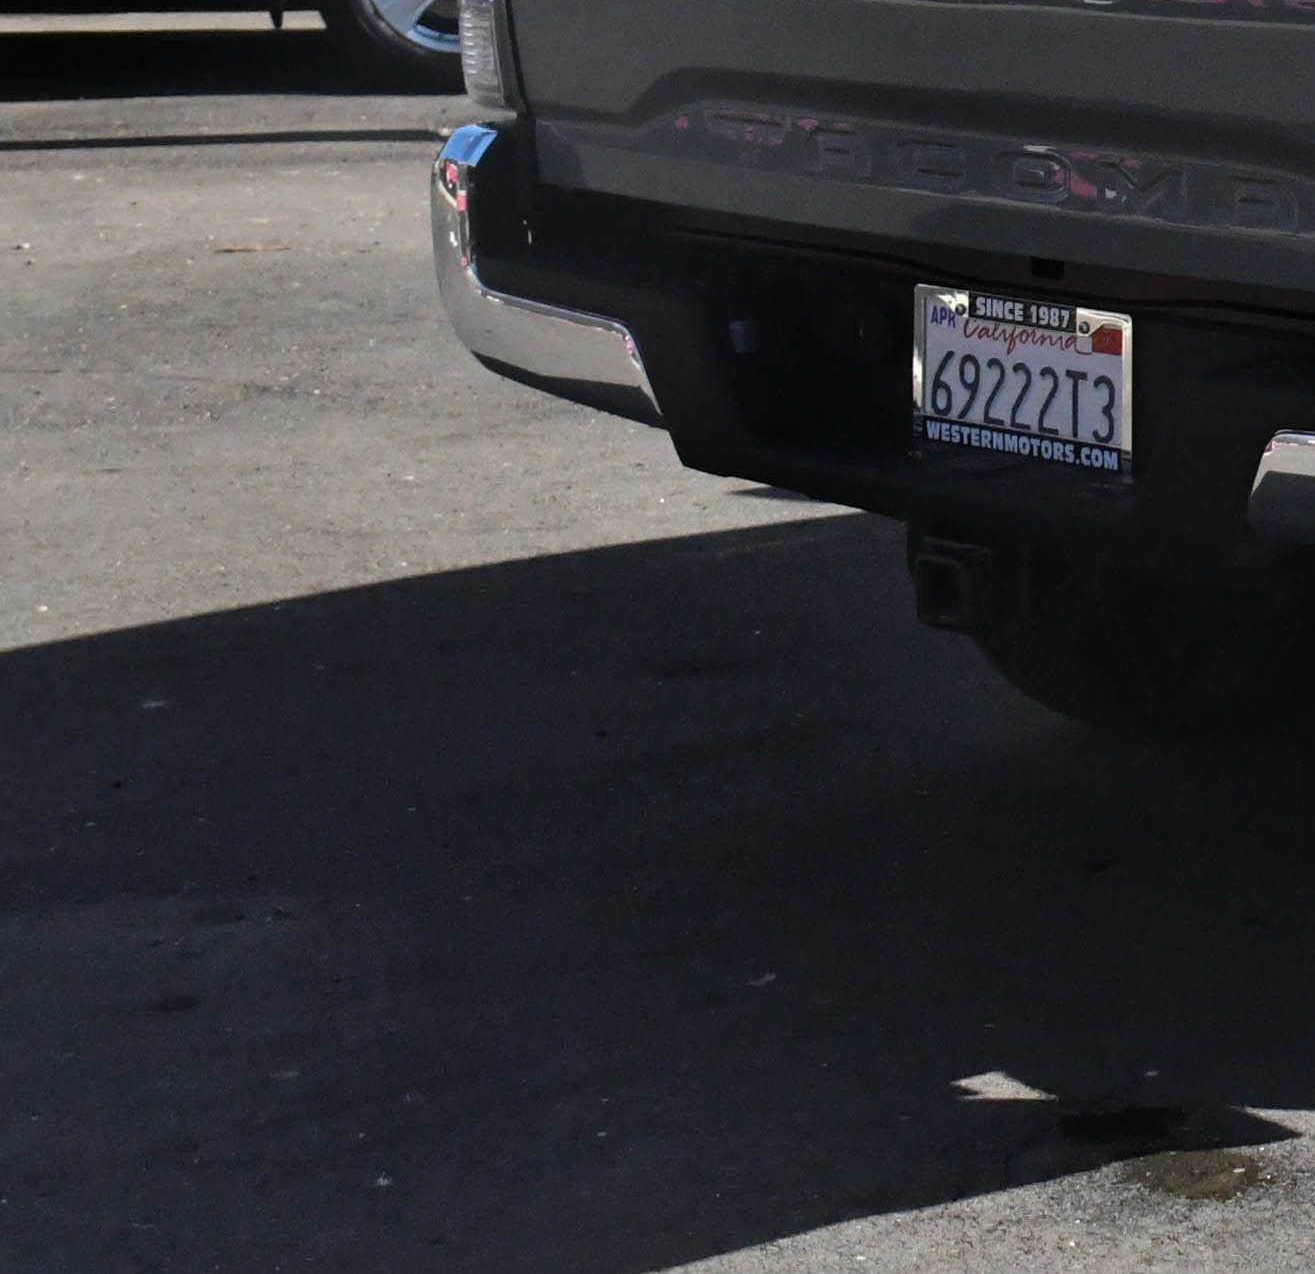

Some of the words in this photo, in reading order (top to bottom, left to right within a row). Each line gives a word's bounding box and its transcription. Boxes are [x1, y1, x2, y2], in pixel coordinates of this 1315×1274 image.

[976, 296, 1024, 322] SINCE
[1030, 304, 1070, 327] 1987
[964, 319, 1093, 356] California
[931, 350, 1116, 444] 69222T3
[926, 419, 1119, 471] WESTERNMOTORS.COM
